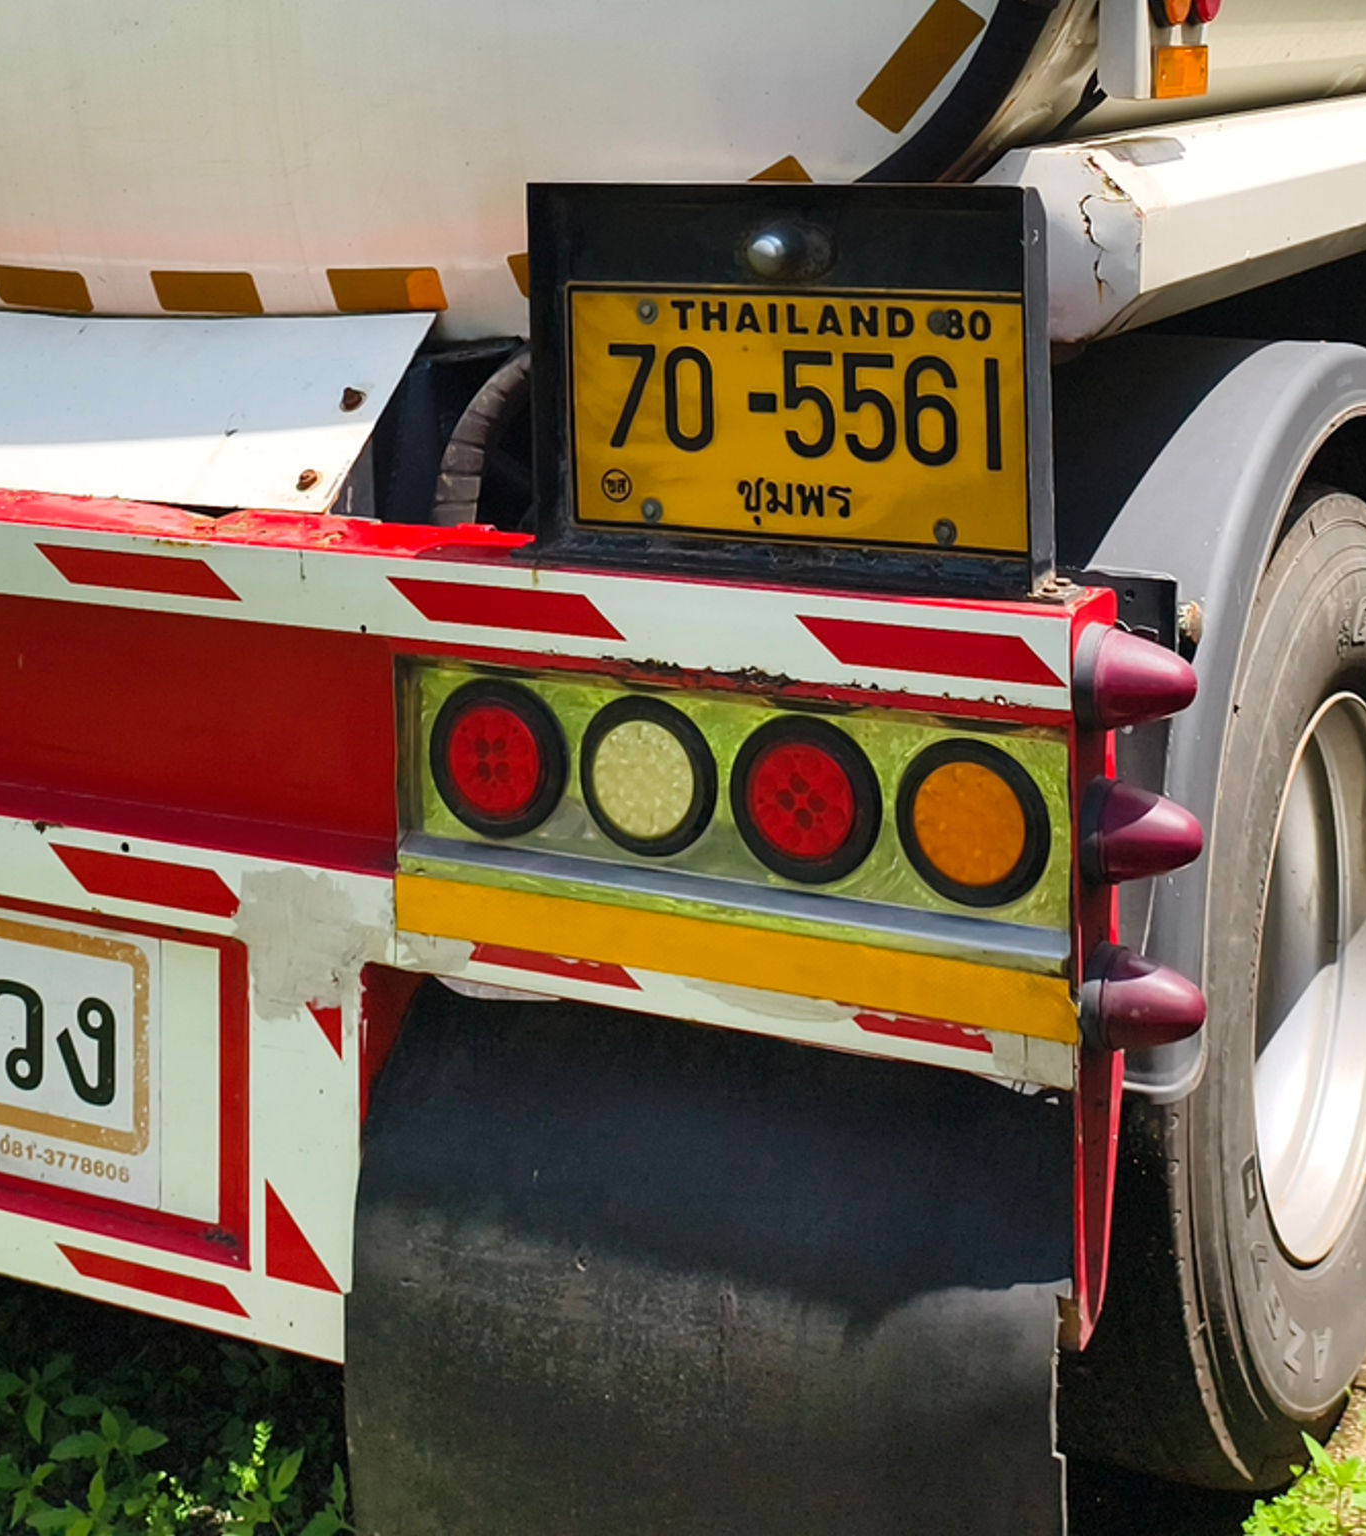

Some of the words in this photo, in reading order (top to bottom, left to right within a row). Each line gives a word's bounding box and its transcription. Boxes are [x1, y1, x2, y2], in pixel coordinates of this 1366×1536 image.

[670, 300, 916, 339] THAILAND
[943, 308, 992, 342] 80
[607, 342, 1003, 472] 70-5561
[737, 476, 853, 526] ชุมพร
